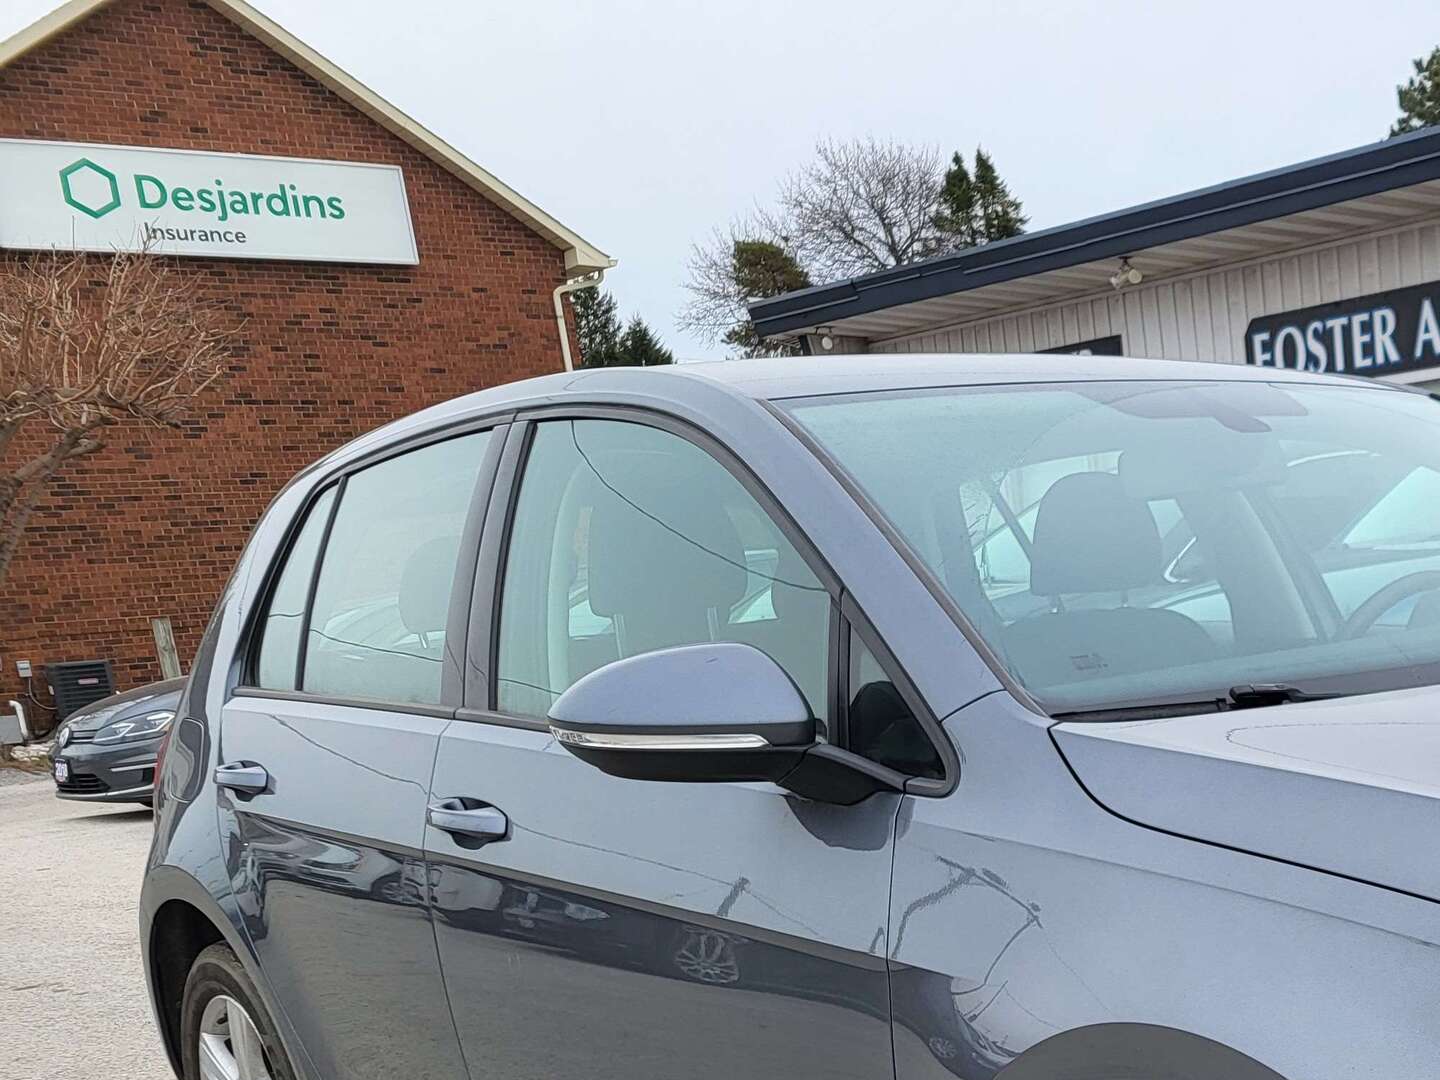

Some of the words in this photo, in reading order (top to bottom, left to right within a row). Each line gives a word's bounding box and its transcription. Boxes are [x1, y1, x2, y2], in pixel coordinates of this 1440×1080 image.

[134, 173, 346, 221] Desjardins
[145, 221, 247, 245] Insurance
[1252, 307, 1400, 373] FOSTER
